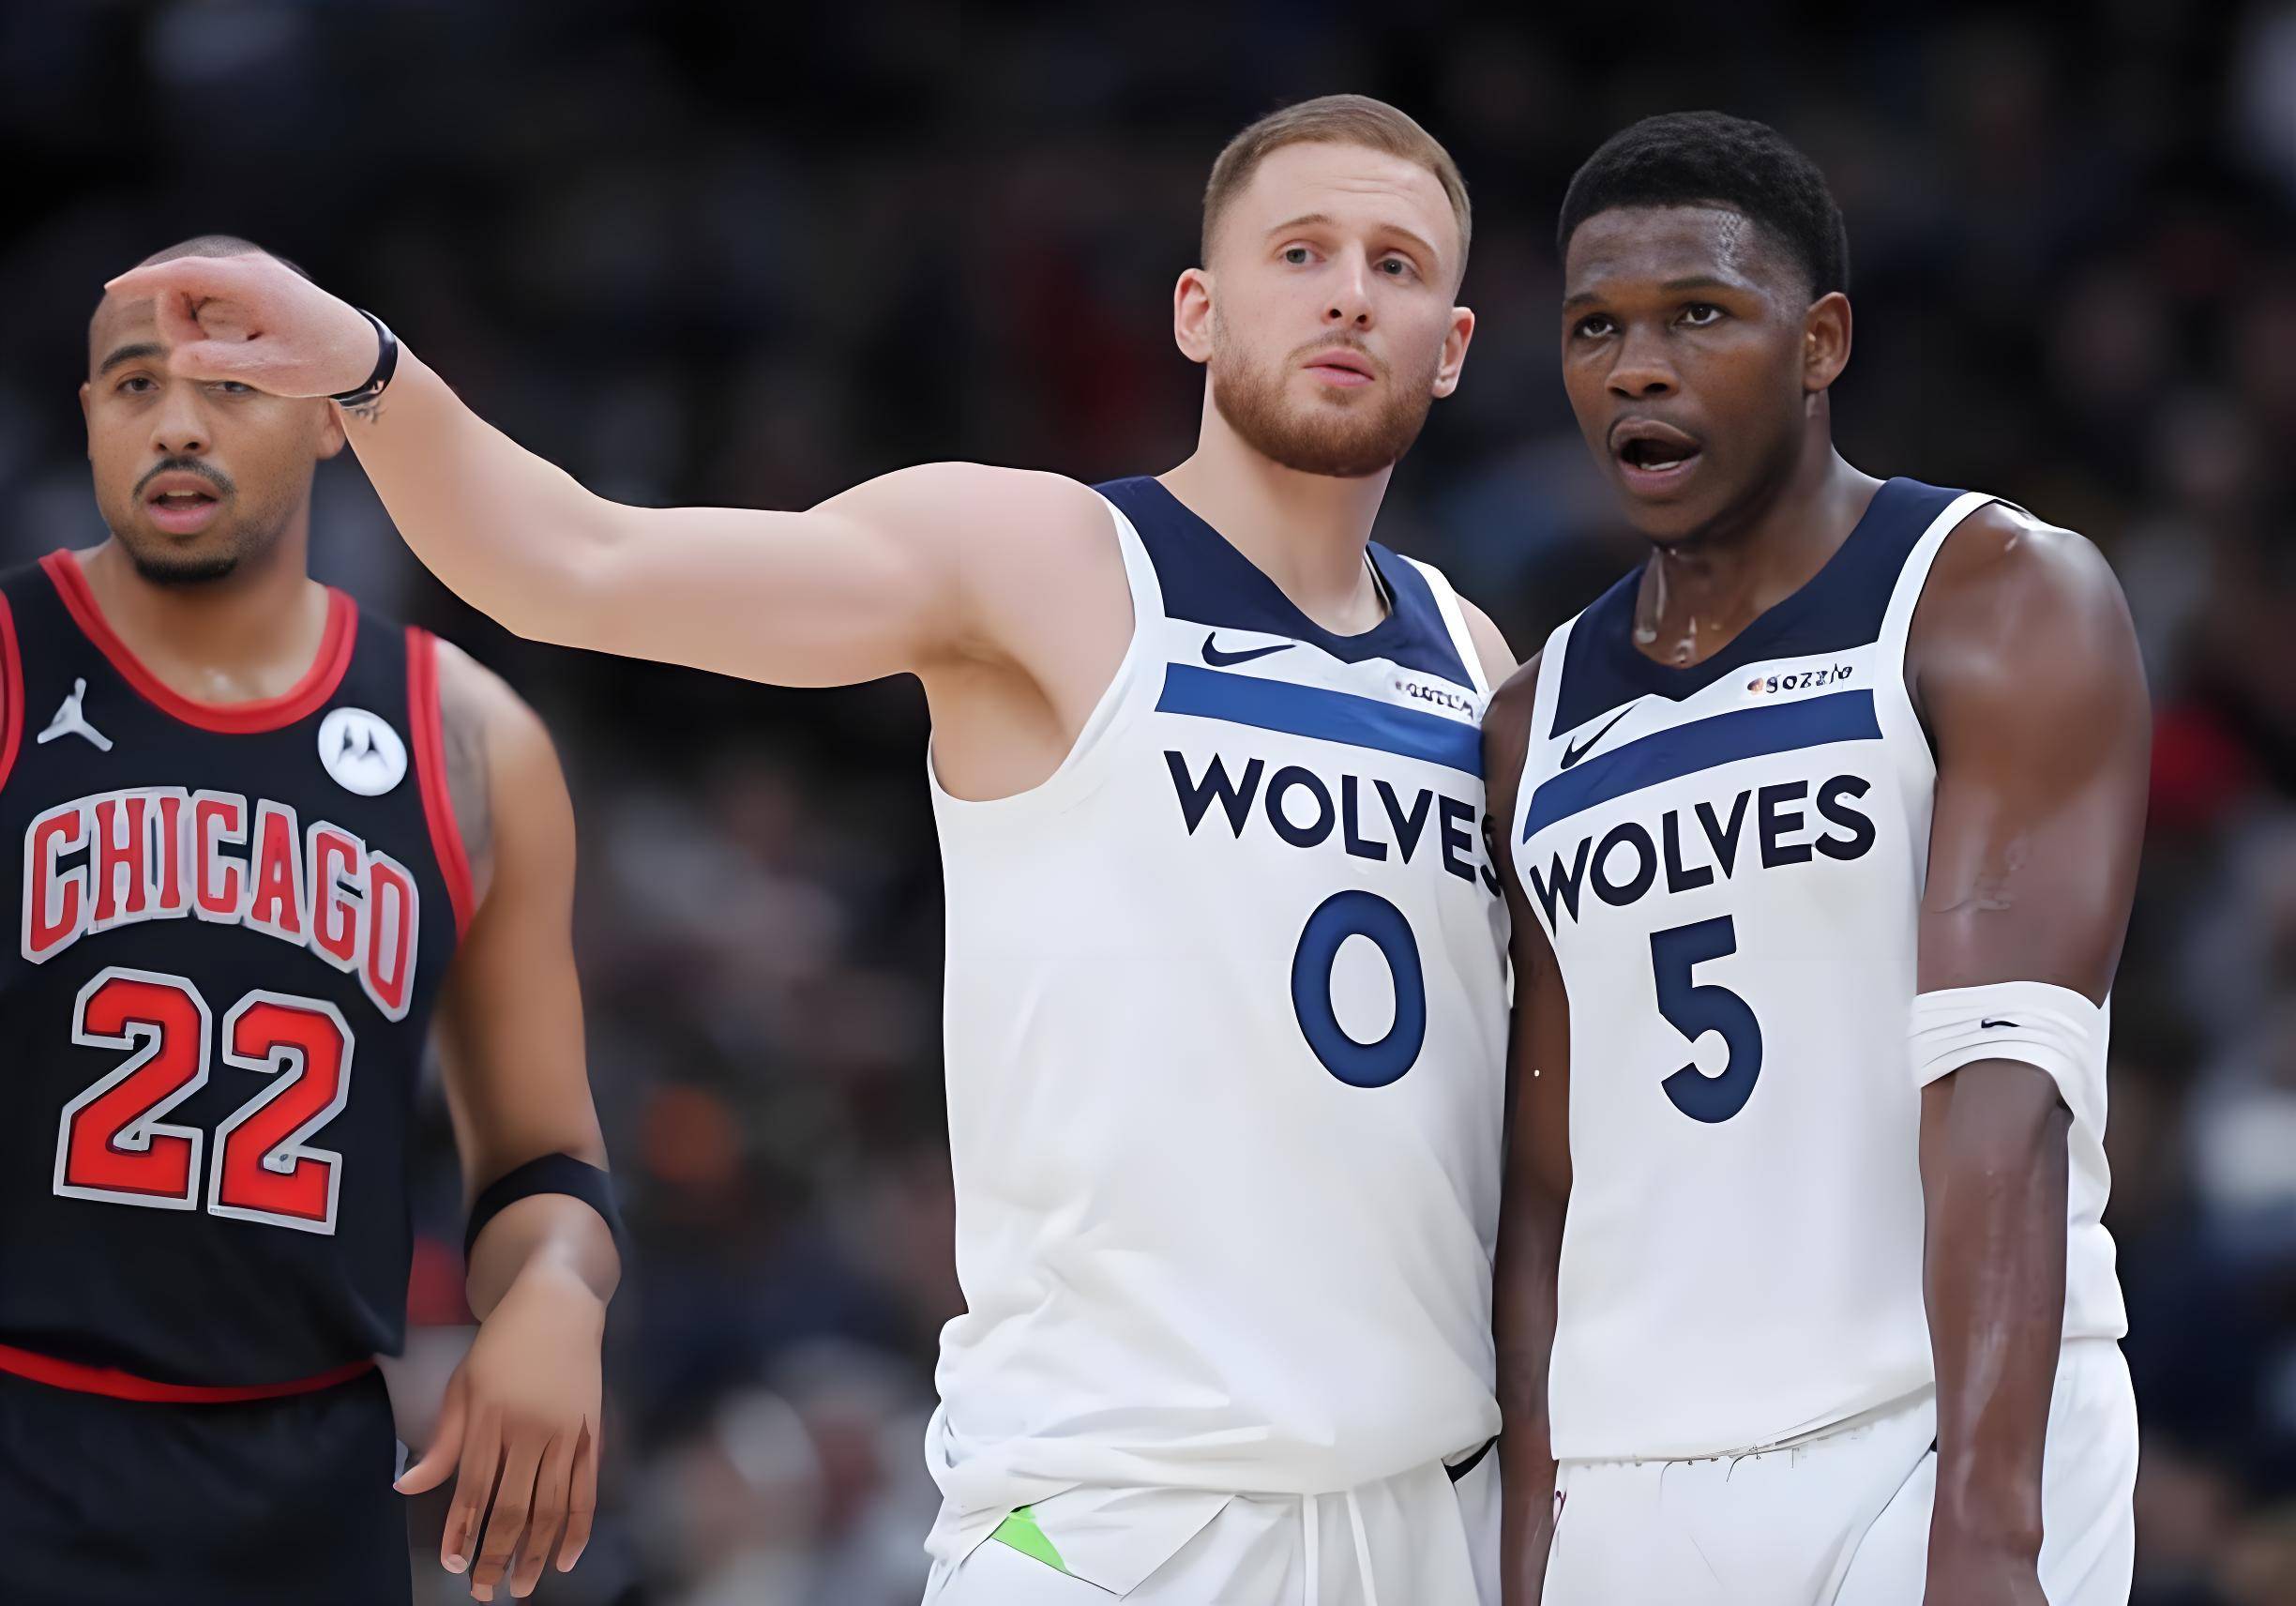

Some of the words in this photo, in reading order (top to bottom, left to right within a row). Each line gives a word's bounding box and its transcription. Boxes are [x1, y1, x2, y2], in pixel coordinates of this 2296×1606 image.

[21, 786, 419, 1023] CHICAGO
[1529, 775, 1877, 938] WOLVES
[1291, 889, 1427, 1088] 0
[1650, 915, 1763, 1124] 5
[53, 966, 355, 1235] 22
